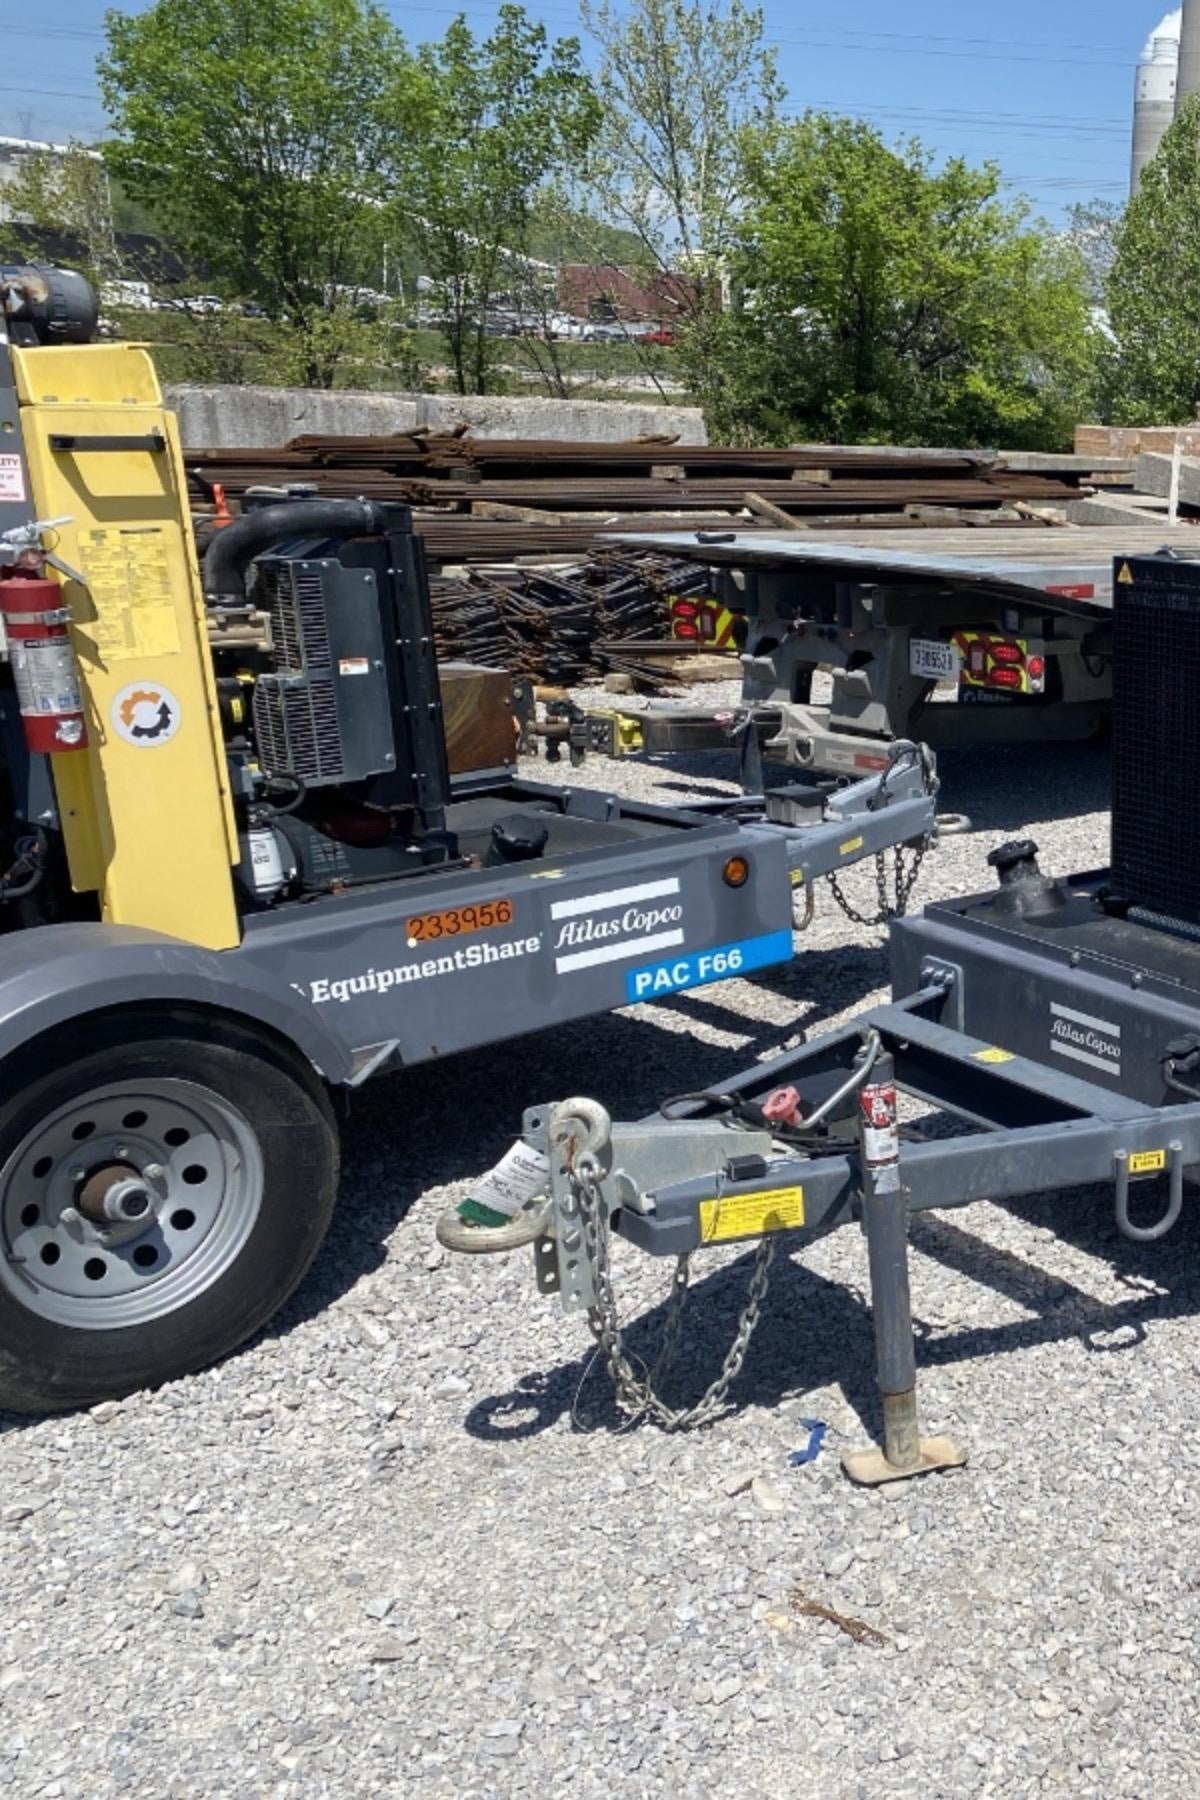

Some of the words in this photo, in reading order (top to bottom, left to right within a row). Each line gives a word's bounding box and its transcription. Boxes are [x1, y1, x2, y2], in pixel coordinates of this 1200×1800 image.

[409, 901, 512, 942] 233956
[309, 936, 541, 1003] EquipmentShare
[635, 962, 691, 996] PAC
[698, 949, 743, 980] F66
